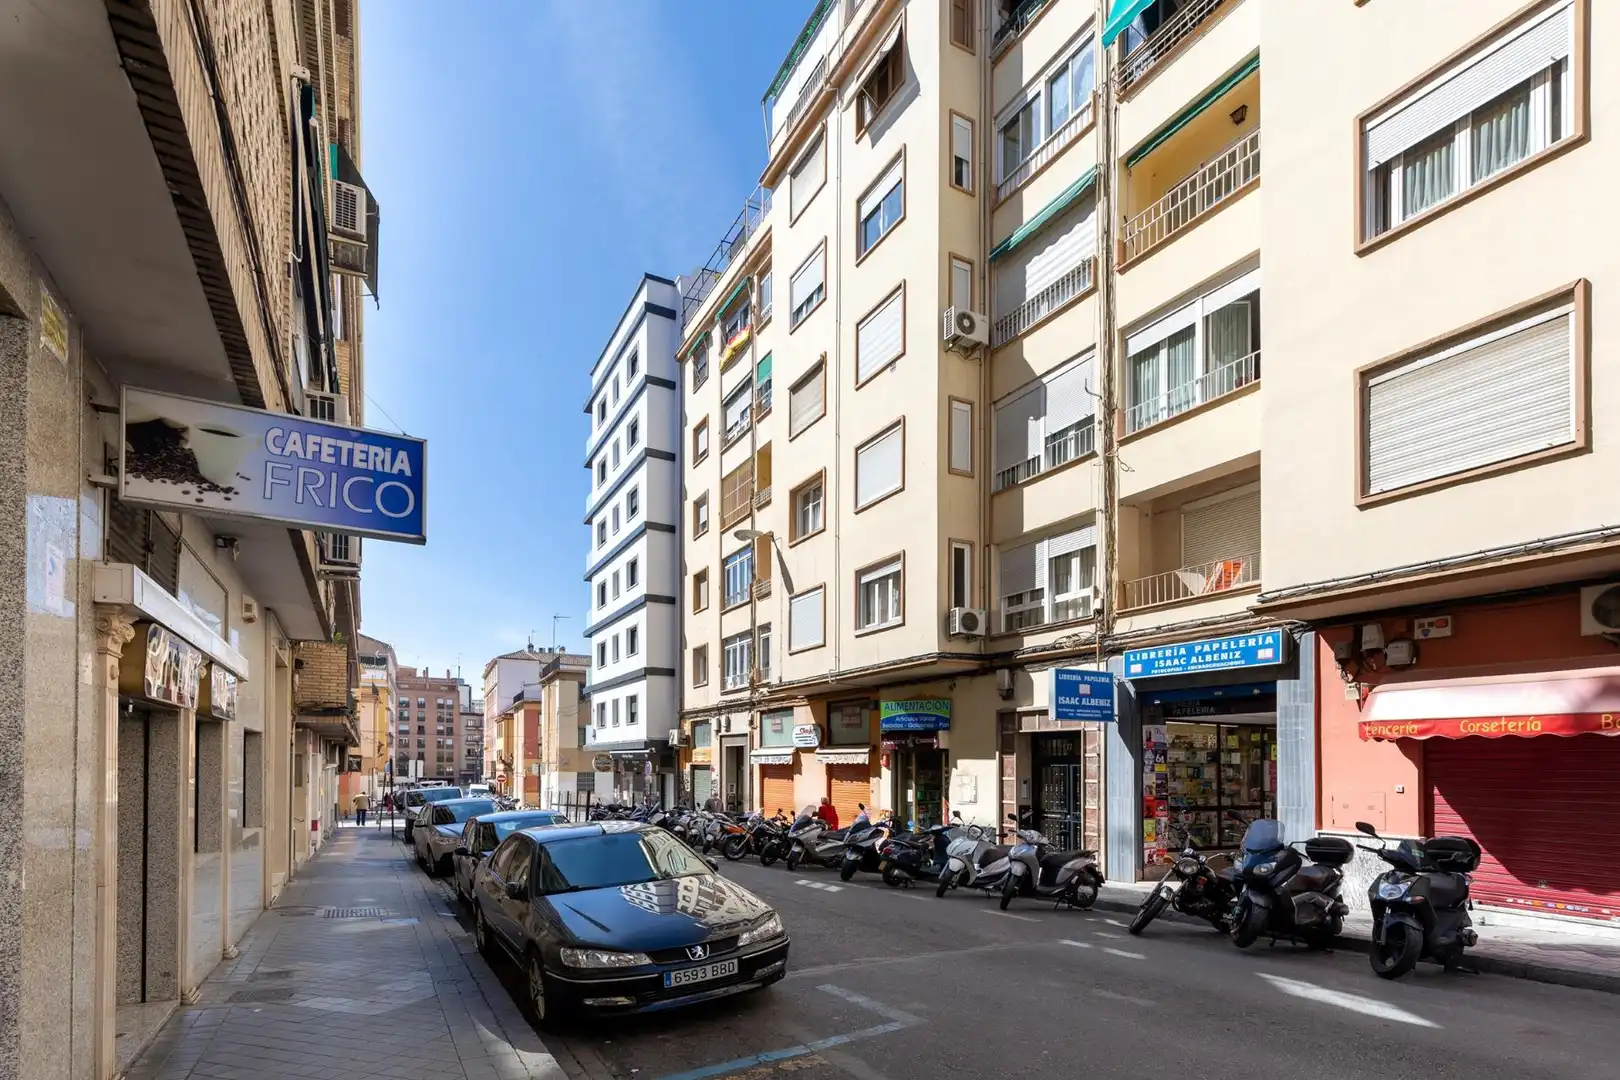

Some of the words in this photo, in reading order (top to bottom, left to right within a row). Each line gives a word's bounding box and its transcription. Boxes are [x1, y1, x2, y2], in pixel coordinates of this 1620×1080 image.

[263, 460, 415, 518] FRICO
[1130, 646, 1187, 661] LIBRERÍA
[1194, 635, 1274, 653] PAPELERÍA
[1154, 658, 1186, 668] ISAAC
[1190, 650, 1241, 664] ALBENIZ
[1058, 696, 1080, 705] ISAAC
[1081, 697, 1111, 707] ALBENIZ
[1459, 716, 1542, 733] Corsetería
[674, 967, 708, 984] 6593
[711, 961, 735, 977] BBD
